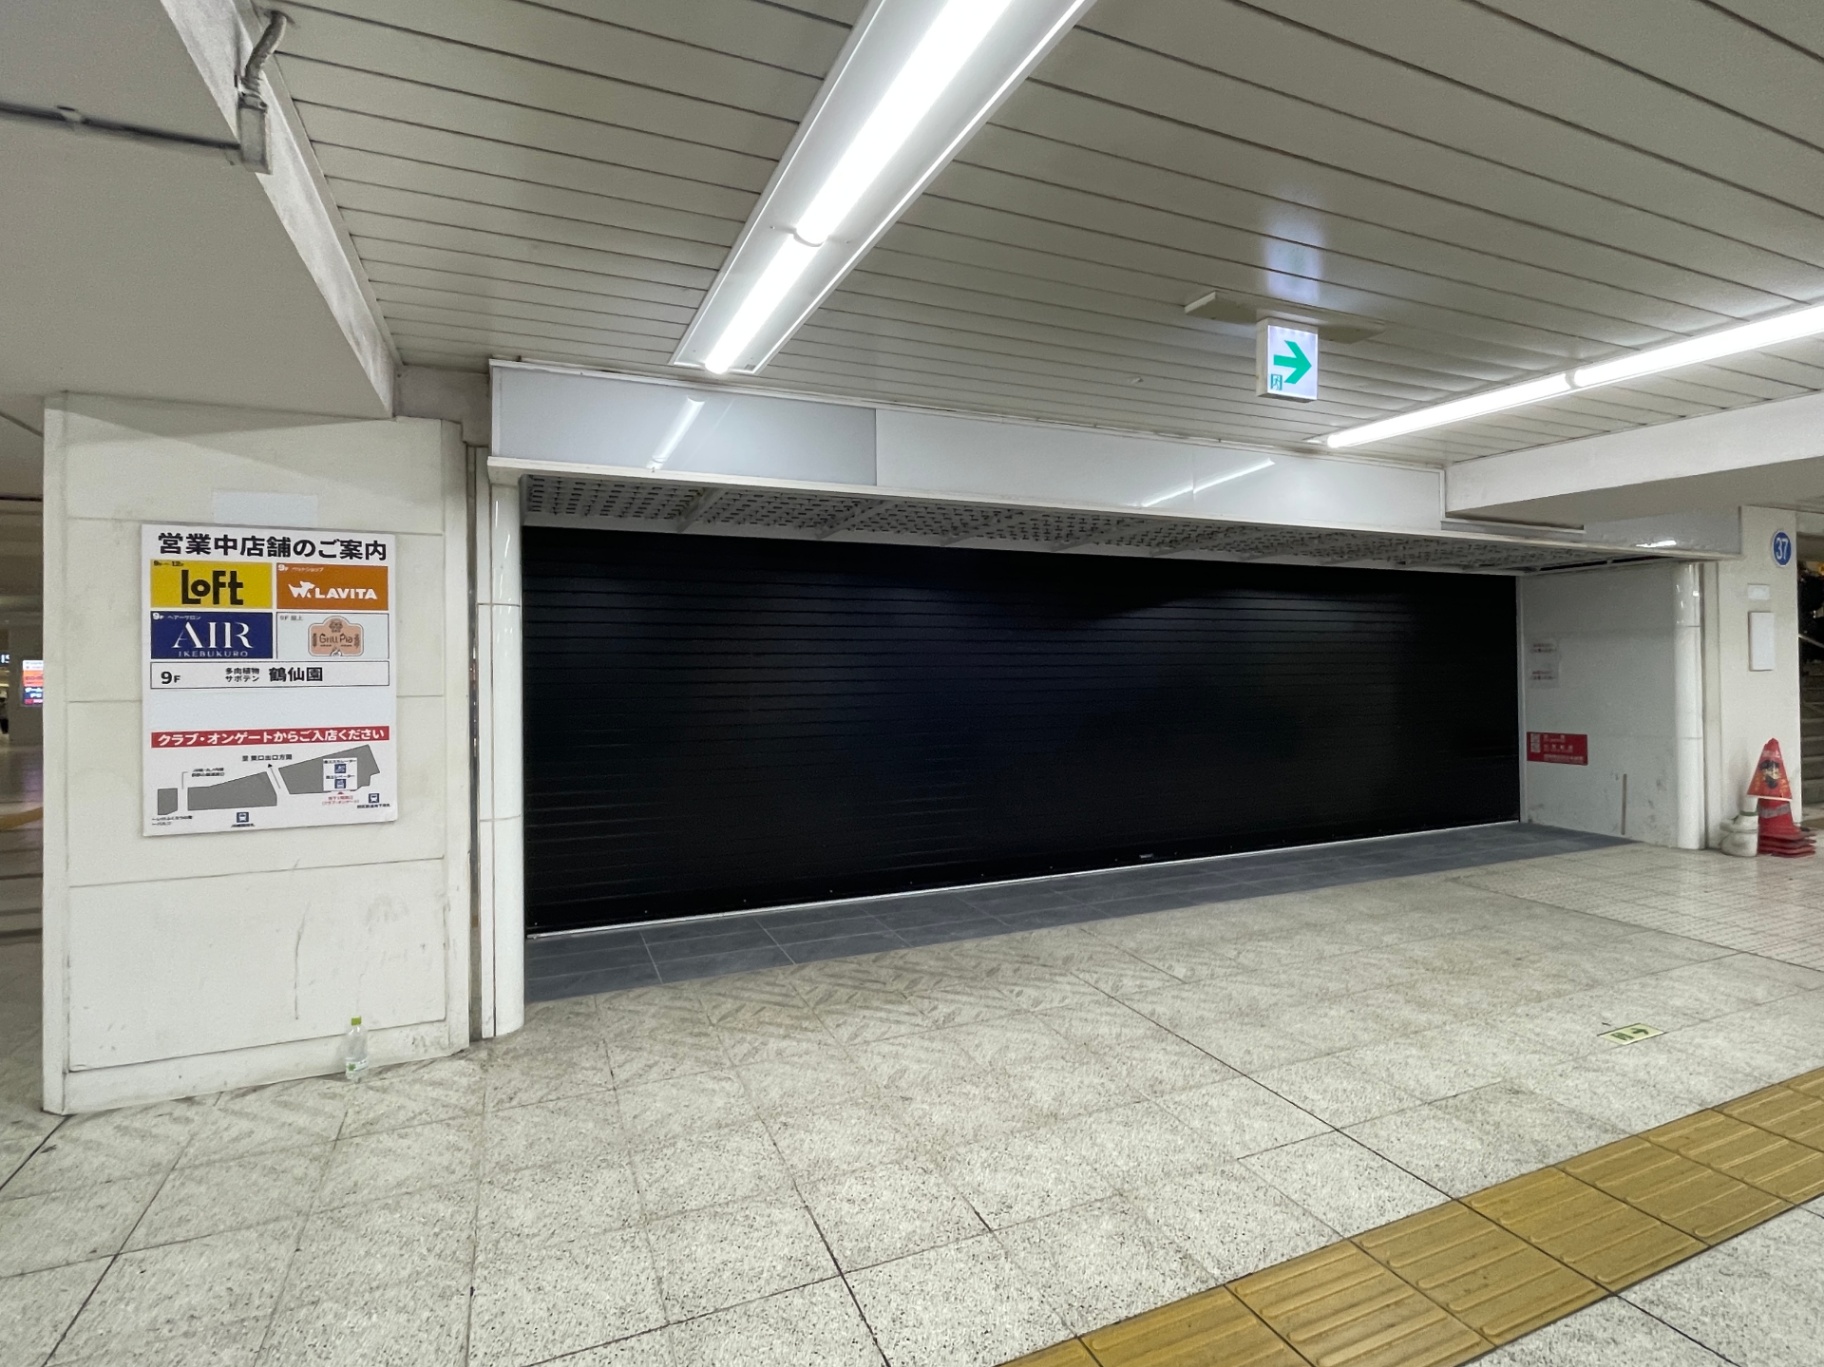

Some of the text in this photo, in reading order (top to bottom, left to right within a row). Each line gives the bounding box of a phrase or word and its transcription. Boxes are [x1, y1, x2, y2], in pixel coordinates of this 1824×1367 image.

[158, 532, 387, 561] 営業中店舗のご案内
[1775, 537, 1789, 560] 37
[314, 587, 378, 600] LAVITA
[171, 621, 254, 649] AIR
[178, 650, 249, 658] IKEBUKURO
[160, 671, 181, 685] 9F
[225, 667, 260, 675] 多肉植物
[225, 674, 260, 683] サボテン
[269, 666, 323, 683] 鶴仙園
[158, 728, 385, 747] クラブ・オンゲートからご入店ください
